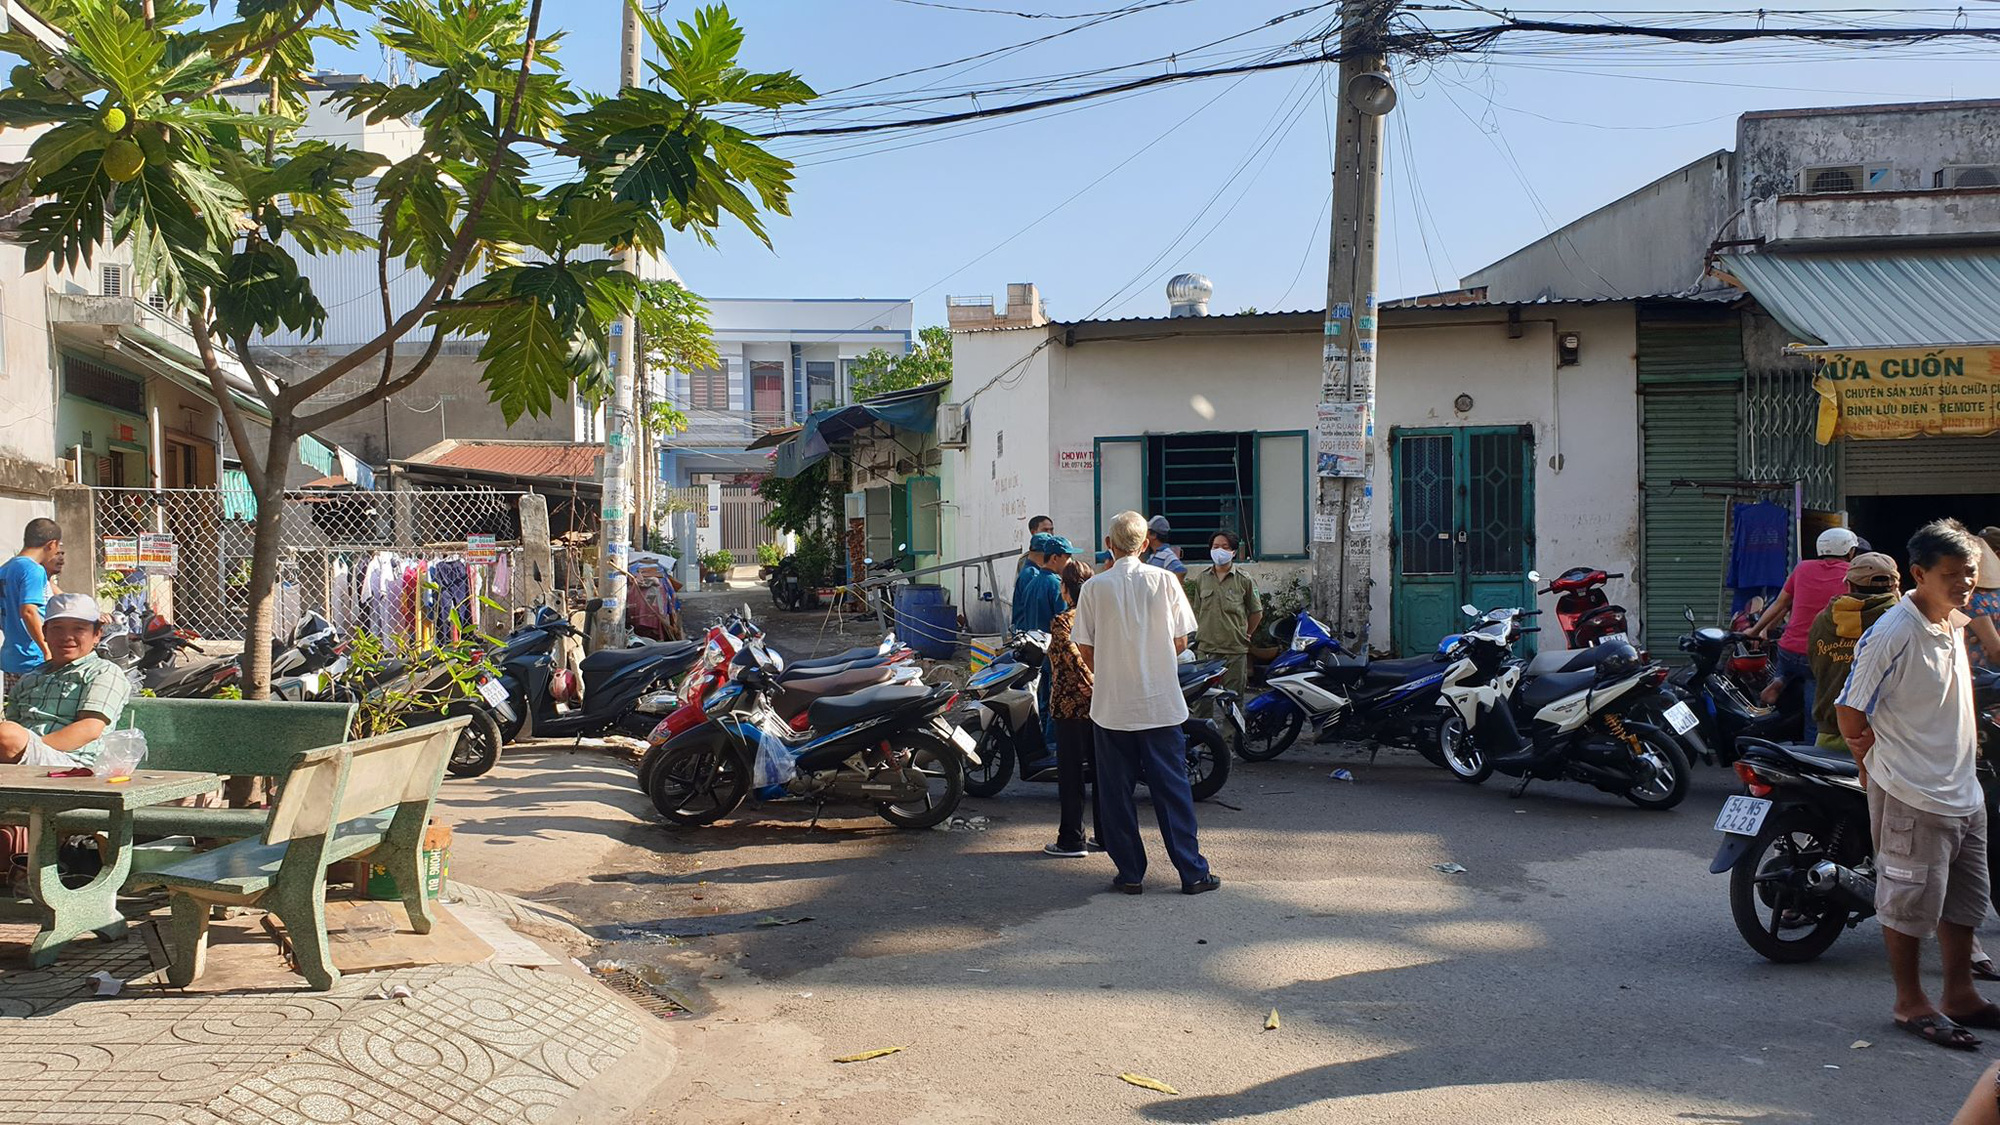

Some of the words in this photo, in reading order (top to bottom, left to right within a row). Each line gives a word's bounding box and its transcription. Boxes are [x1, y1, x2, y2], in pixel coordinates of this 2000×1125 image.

[1881, 349, 1964, 379] CUỐN
[1845, 386, 1884, 398] CHUYÊN
[1886, 383, 1906, 398] SẢN
[1909, 382, 1935, 397] XUẤT
[1938, 382, 1958, 396] SỬA
[1961, 382, 1988, 395] CHỮA
[1901, 401, 1928, 416] ĐIỆN
[1939, 402, 1985, 413] REMOTE
[1722, 814, 1756, 832] 2428
